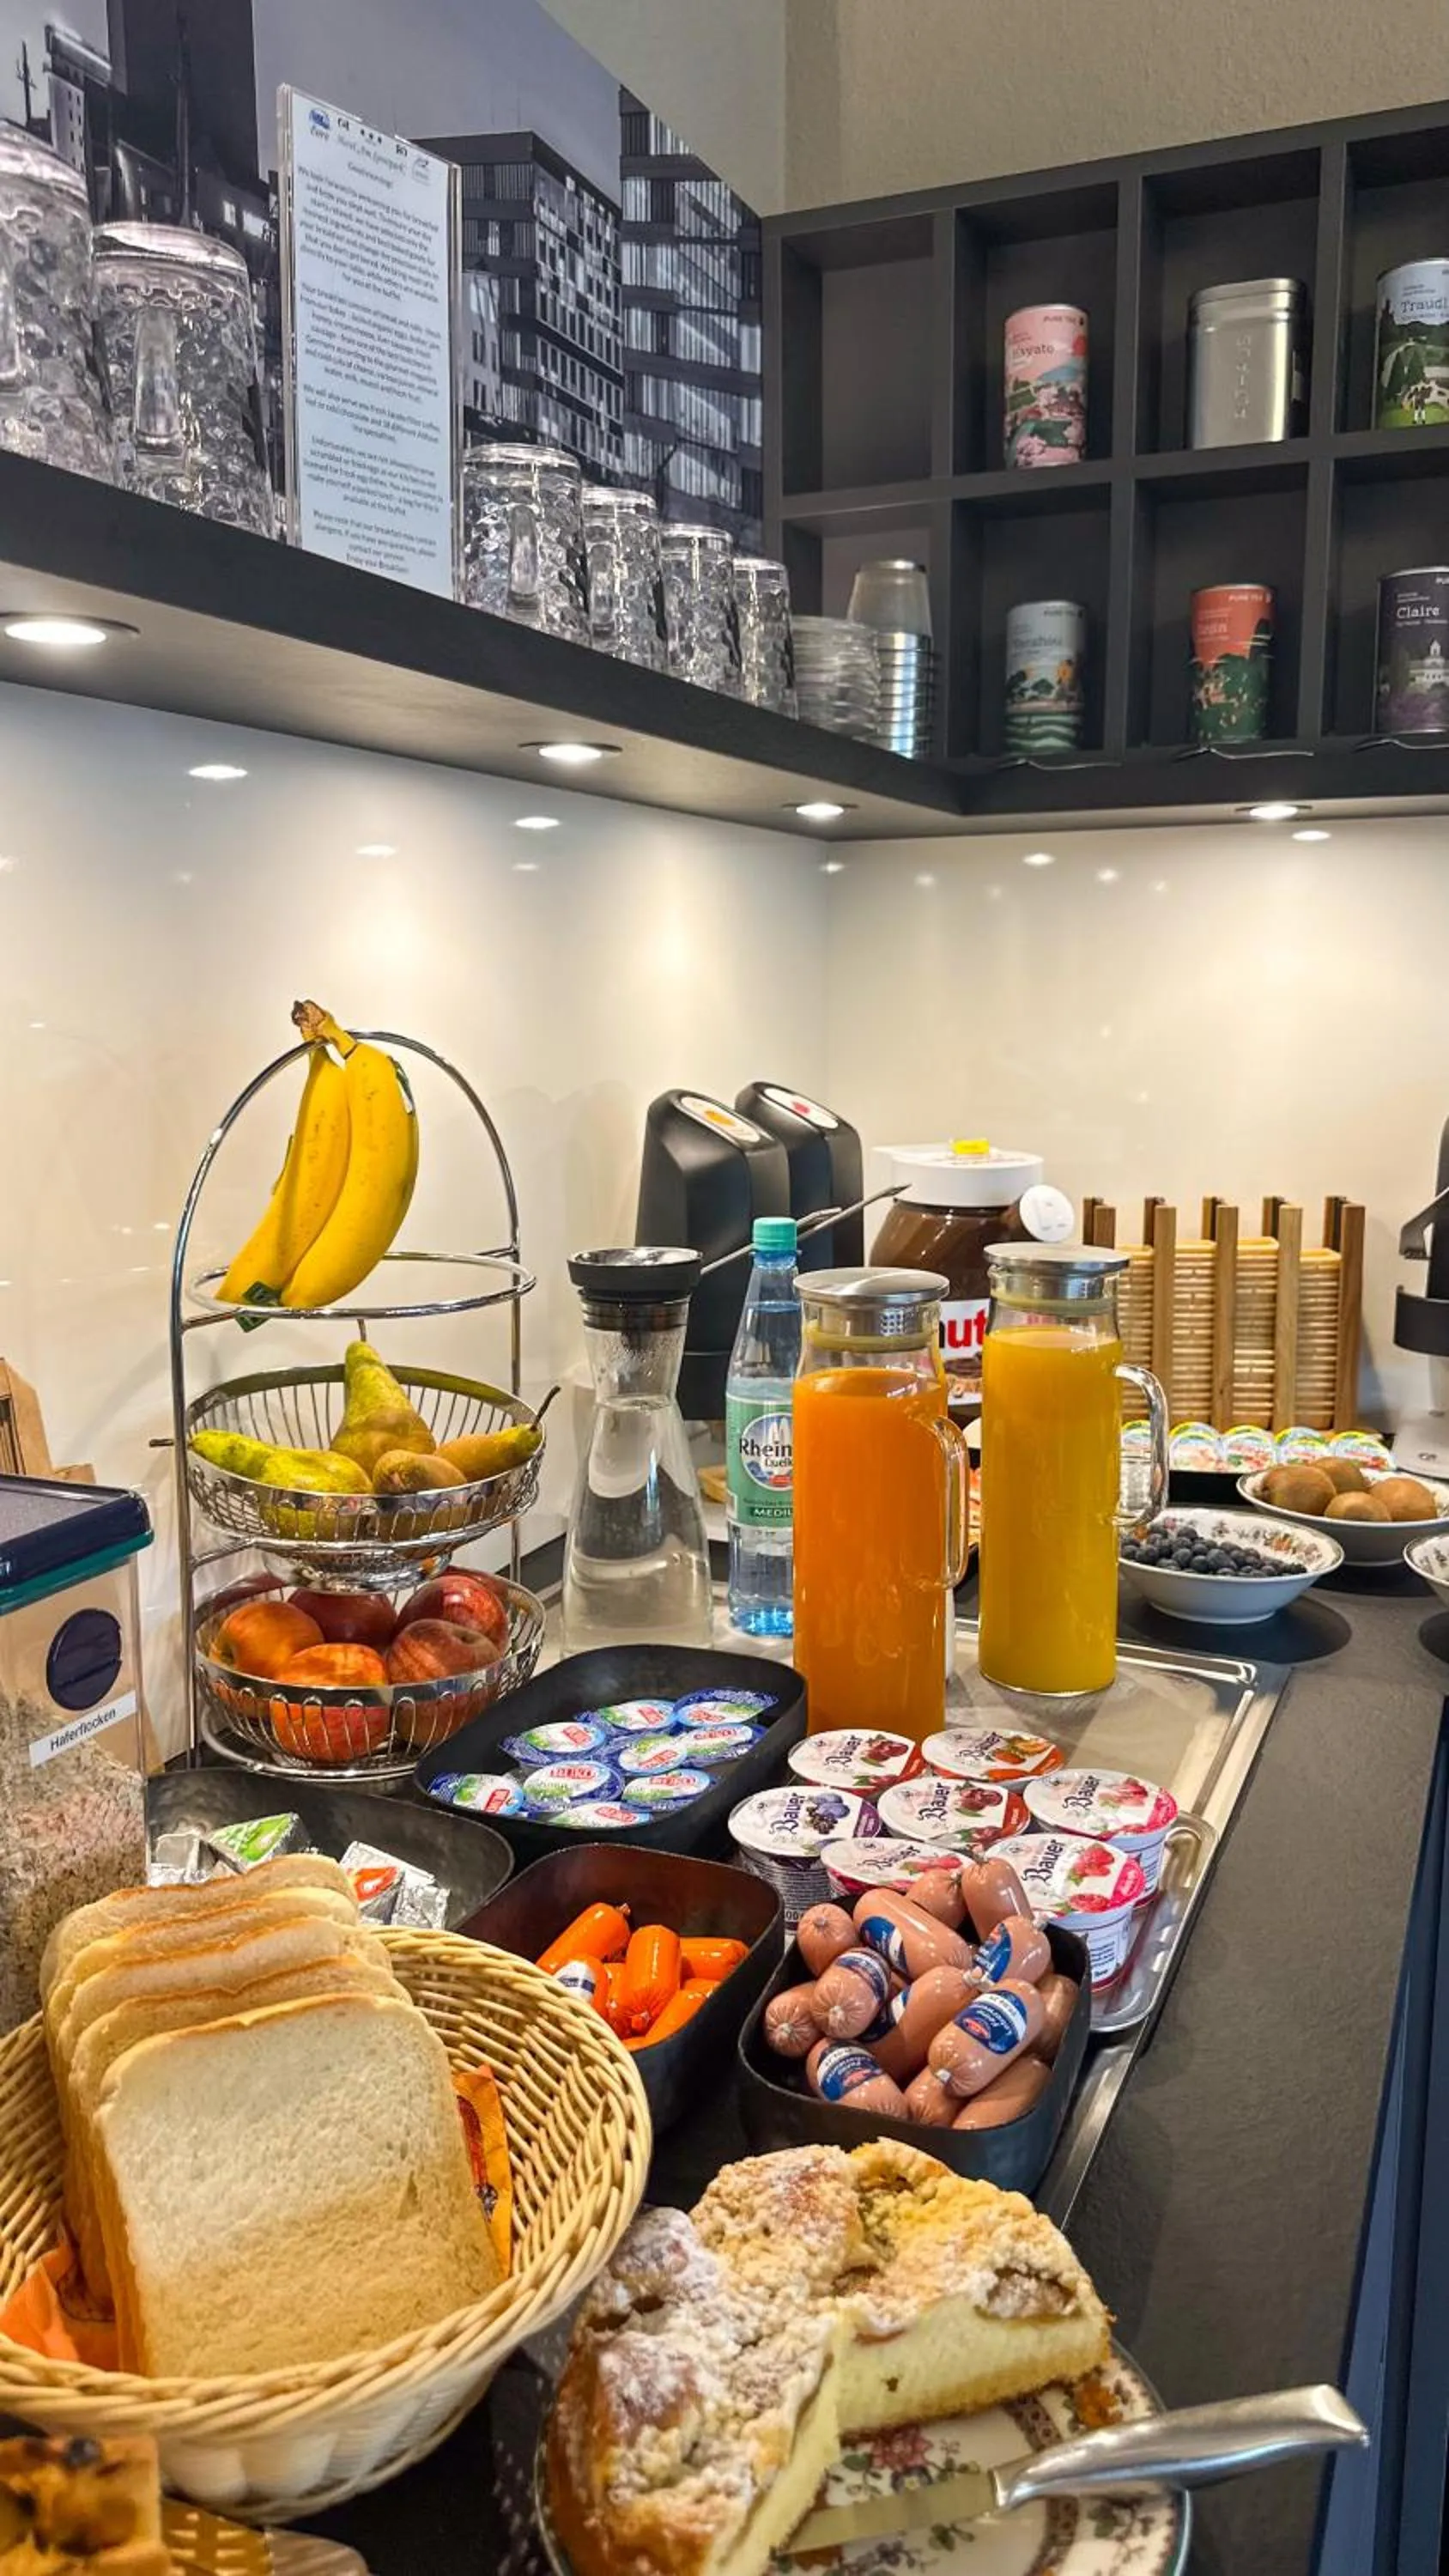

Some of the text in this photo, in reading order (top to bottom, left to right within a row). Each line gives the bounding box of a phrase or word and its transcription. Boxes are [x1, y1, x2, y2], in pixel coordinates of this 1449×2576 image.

[1397, 604, 1440, 618] Claire
[739, 1437, 792, 1457] Rhein
[50, 1708, 116, 1752] Haferflocken
[918, 1783, 951, 1821] Bauer
[1062, 1775, 1102, 1809] Bauer
[769, 1792, 805, 1835] Bauer
[1022, 1839, 1067, 1886] Bauer
